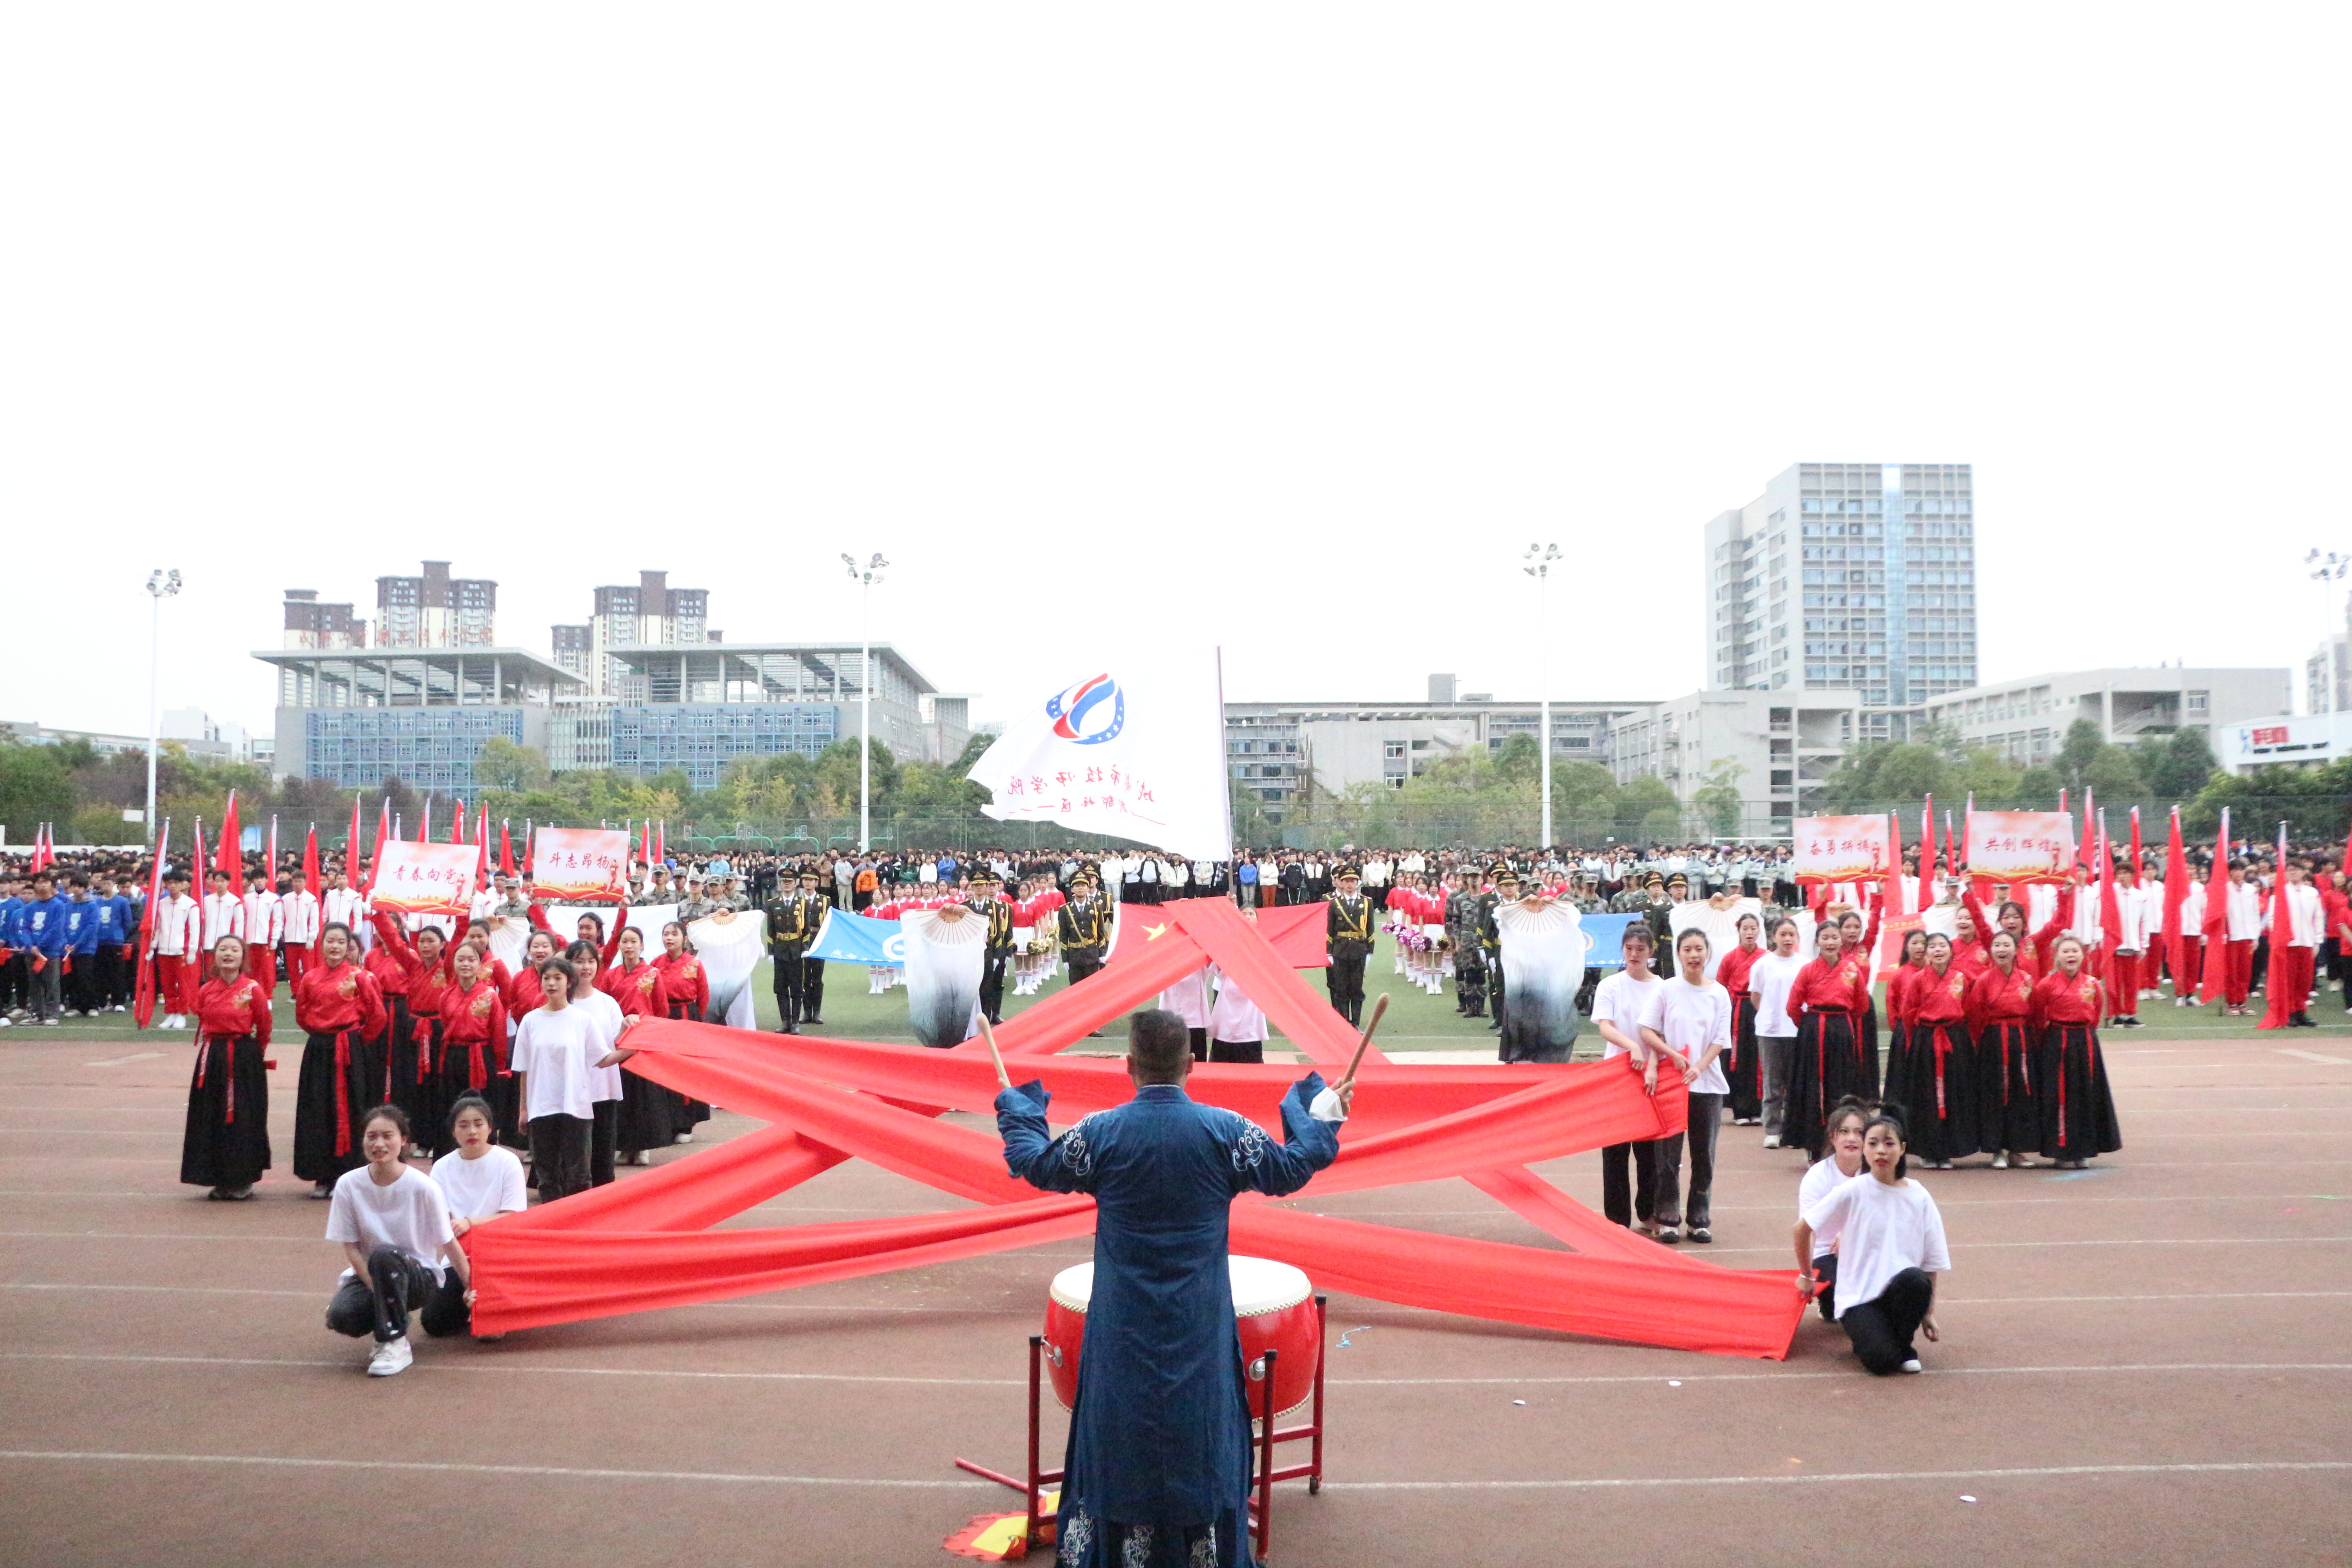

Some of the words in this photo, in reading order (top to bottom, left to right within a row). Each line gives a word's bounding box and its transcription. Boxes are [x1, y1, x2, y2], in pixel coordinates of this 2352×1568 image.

[1809, 838, 1872, 856] 奋勇拼搏
[1984, 836, 2053, 853] 共创辉煌
[549, 852, 610, 869] 斗志昂扬
[392, 866, 456, 885] 青春向党
